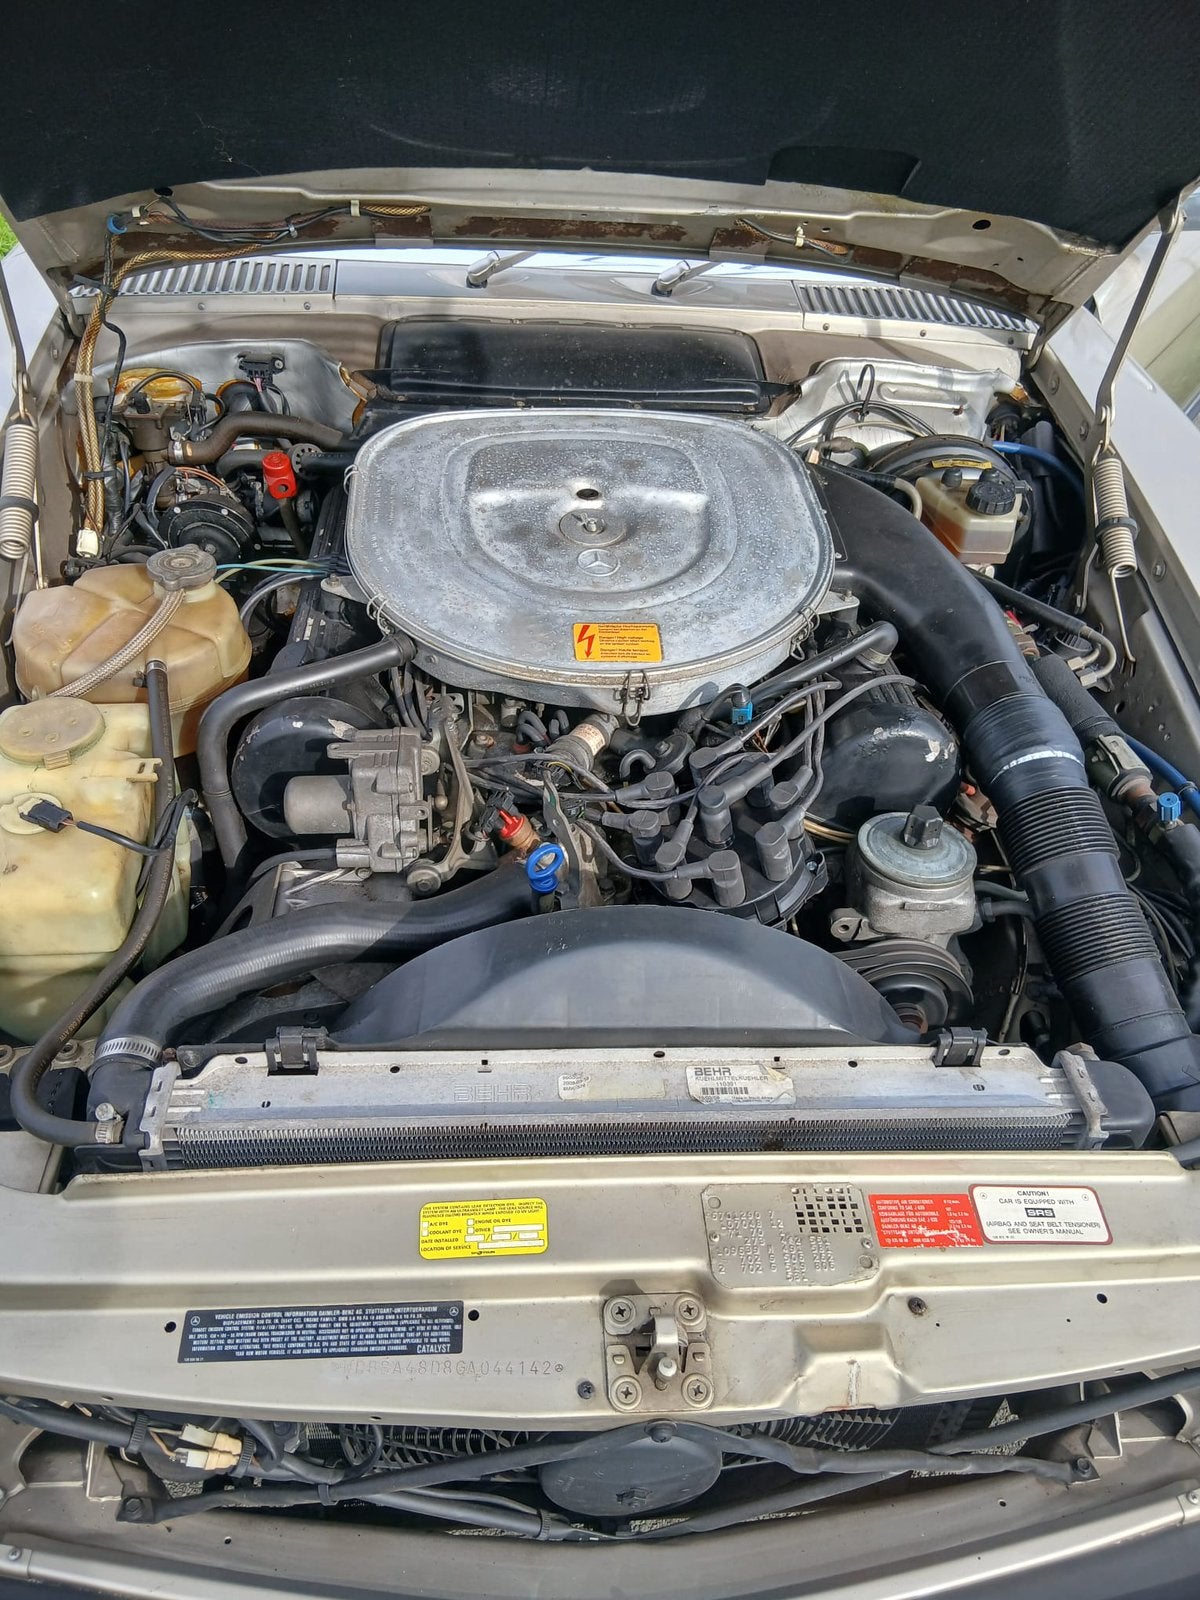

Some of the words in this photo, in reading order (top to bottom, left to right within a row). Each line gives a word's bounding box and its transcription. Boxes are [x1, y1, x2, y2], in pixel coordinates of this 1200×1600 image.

[694, 1067, 731, 1076] BEHR
[454, 1084, 531, 1102] BEHR
[1026, 1209, 1054, 1217] SRS
[417, 1344, 451, 1353] CATALYST
